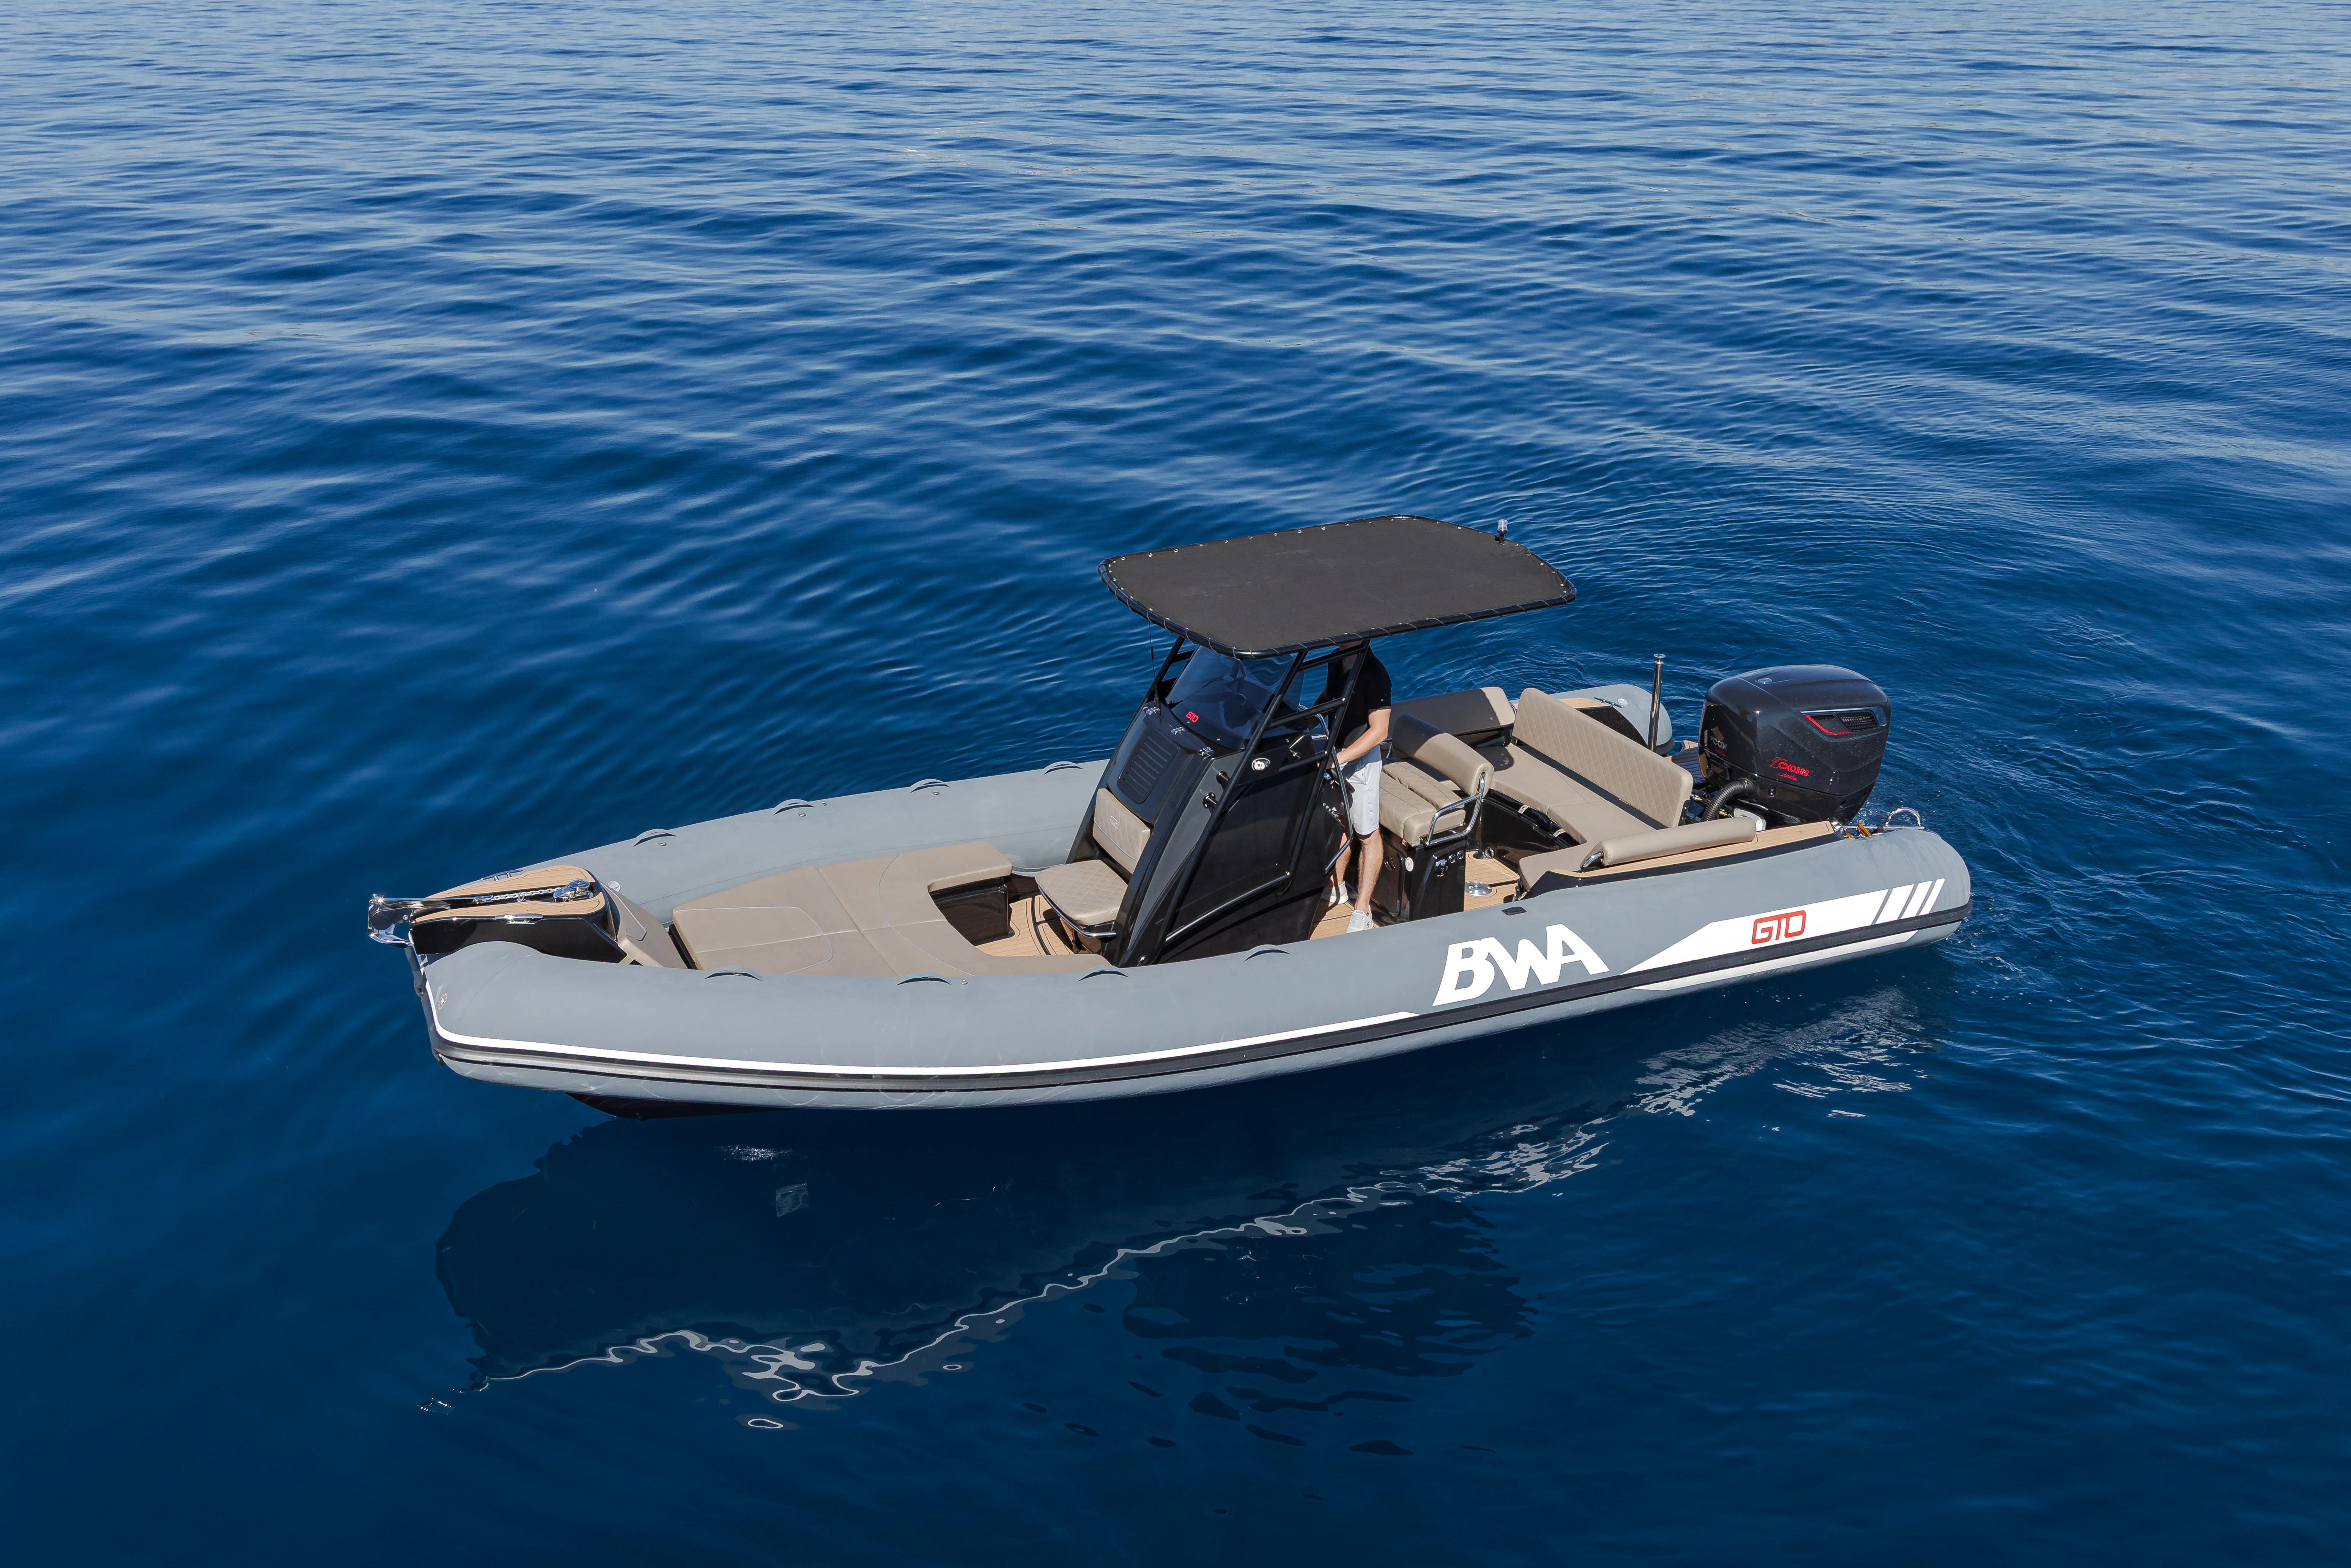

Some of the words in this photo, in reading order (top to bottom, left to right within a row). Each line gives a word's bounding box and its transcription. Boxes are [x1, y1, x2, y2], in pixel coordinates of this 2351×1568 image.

[1186, 711, 1199, 723] GTO
[1713, 738, 1728, 751] COX
[1751, 910, 1806, 944] GTO
[1432, 923, 1610, 1007] BWA
